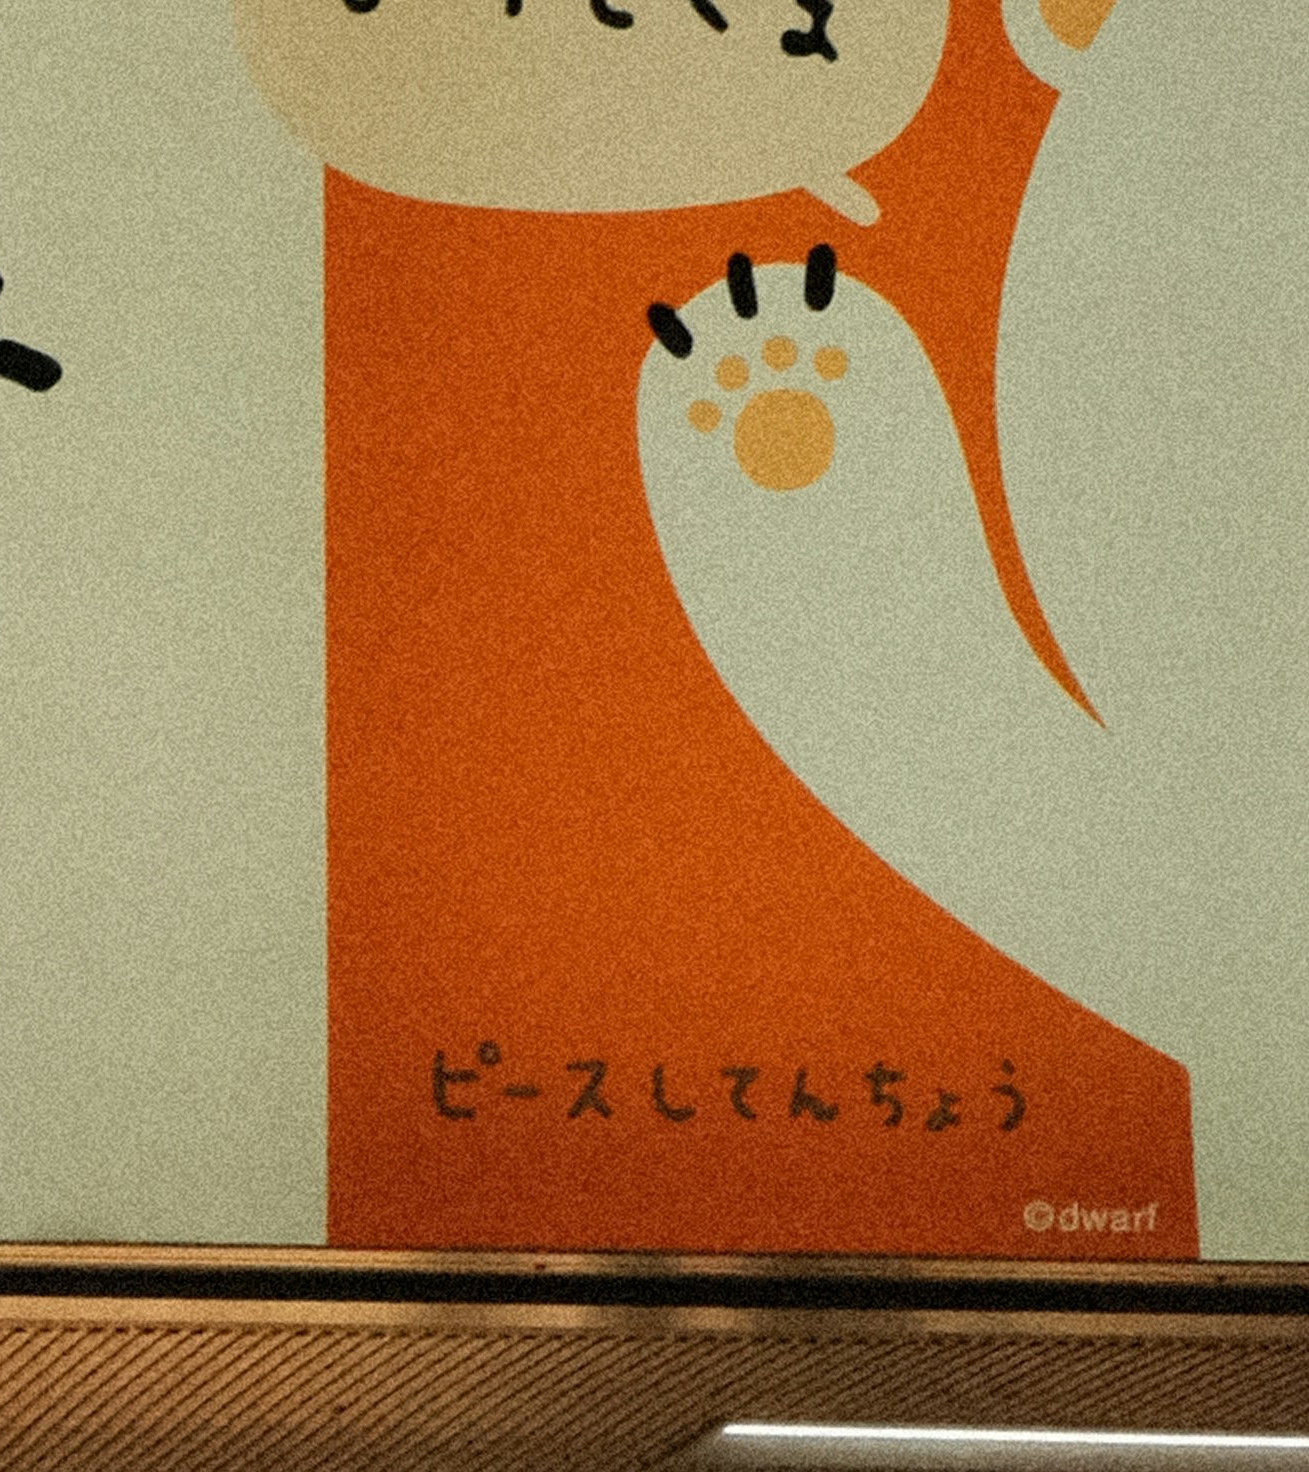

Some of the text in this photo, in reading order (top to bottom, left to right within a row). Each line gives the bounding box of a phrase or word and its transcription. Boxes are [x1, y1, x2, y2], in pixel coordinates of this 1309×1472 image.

[432, 1041, 1028, 1132] ピースしてんちょう
